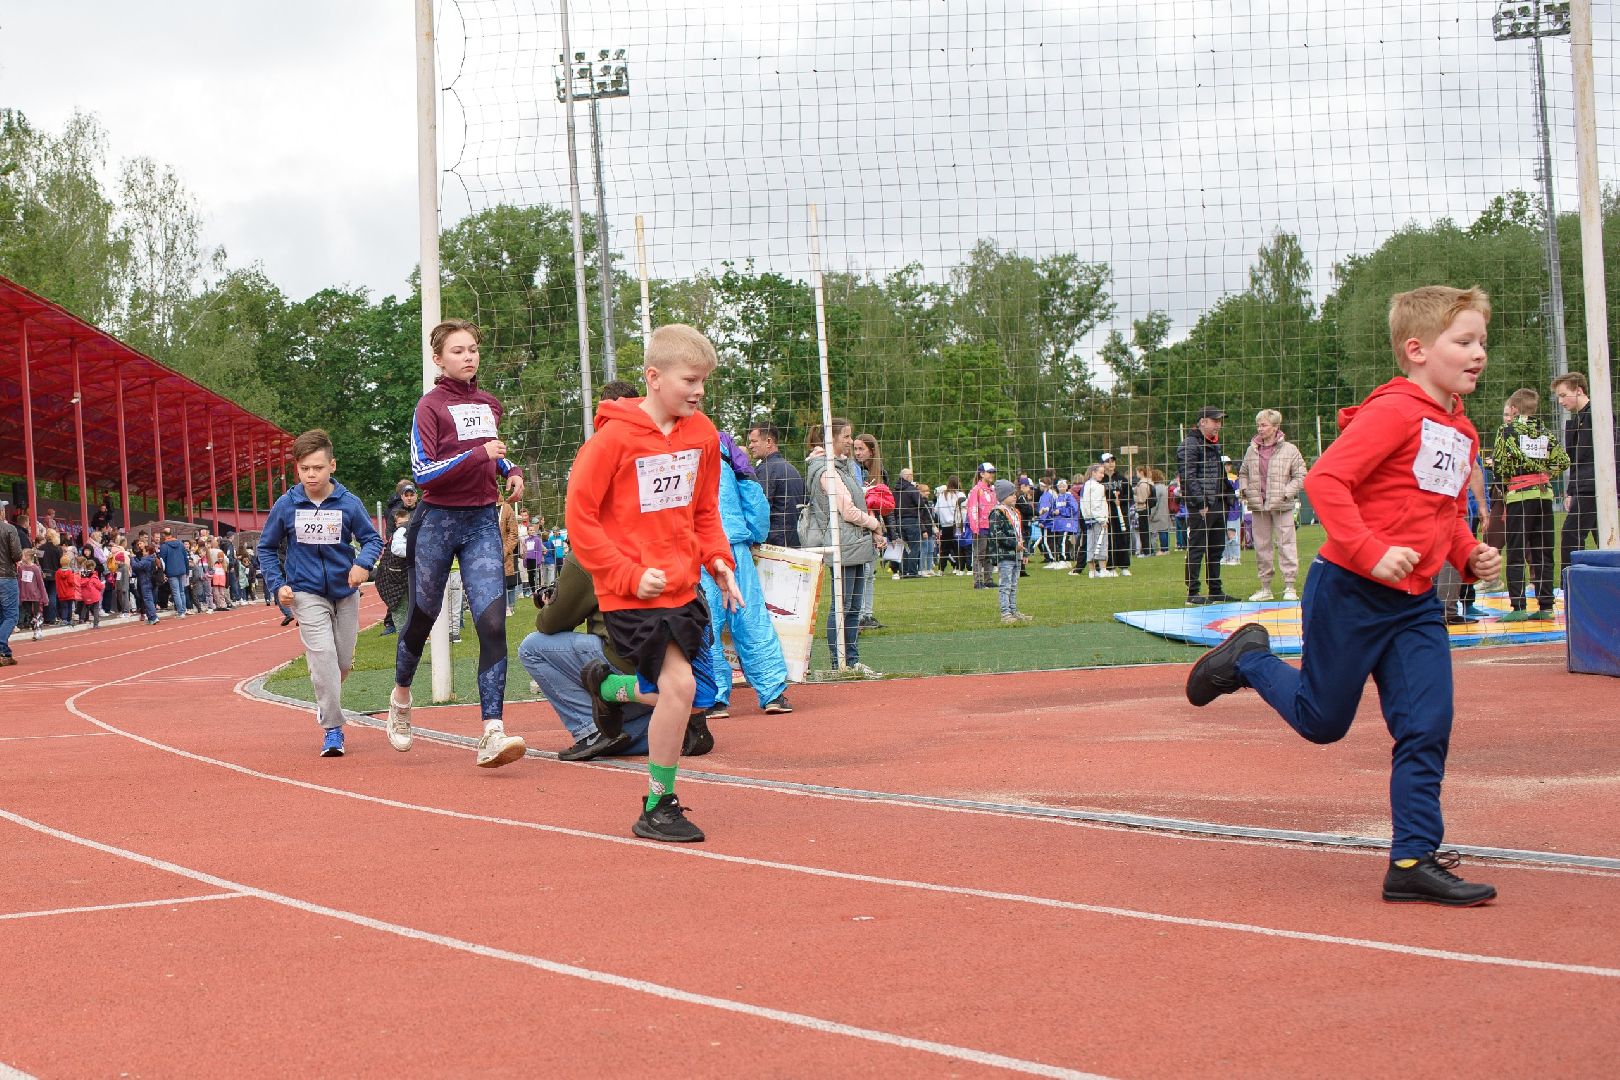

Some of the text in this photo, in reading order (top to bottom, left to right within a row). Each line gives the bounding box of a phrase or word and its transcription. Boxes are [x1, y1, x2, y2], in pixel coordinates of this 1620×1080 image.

[463, 417, 481, 427] 297
[653, 475, 681, 493] 277
[304, 523, 323, 534] 292
